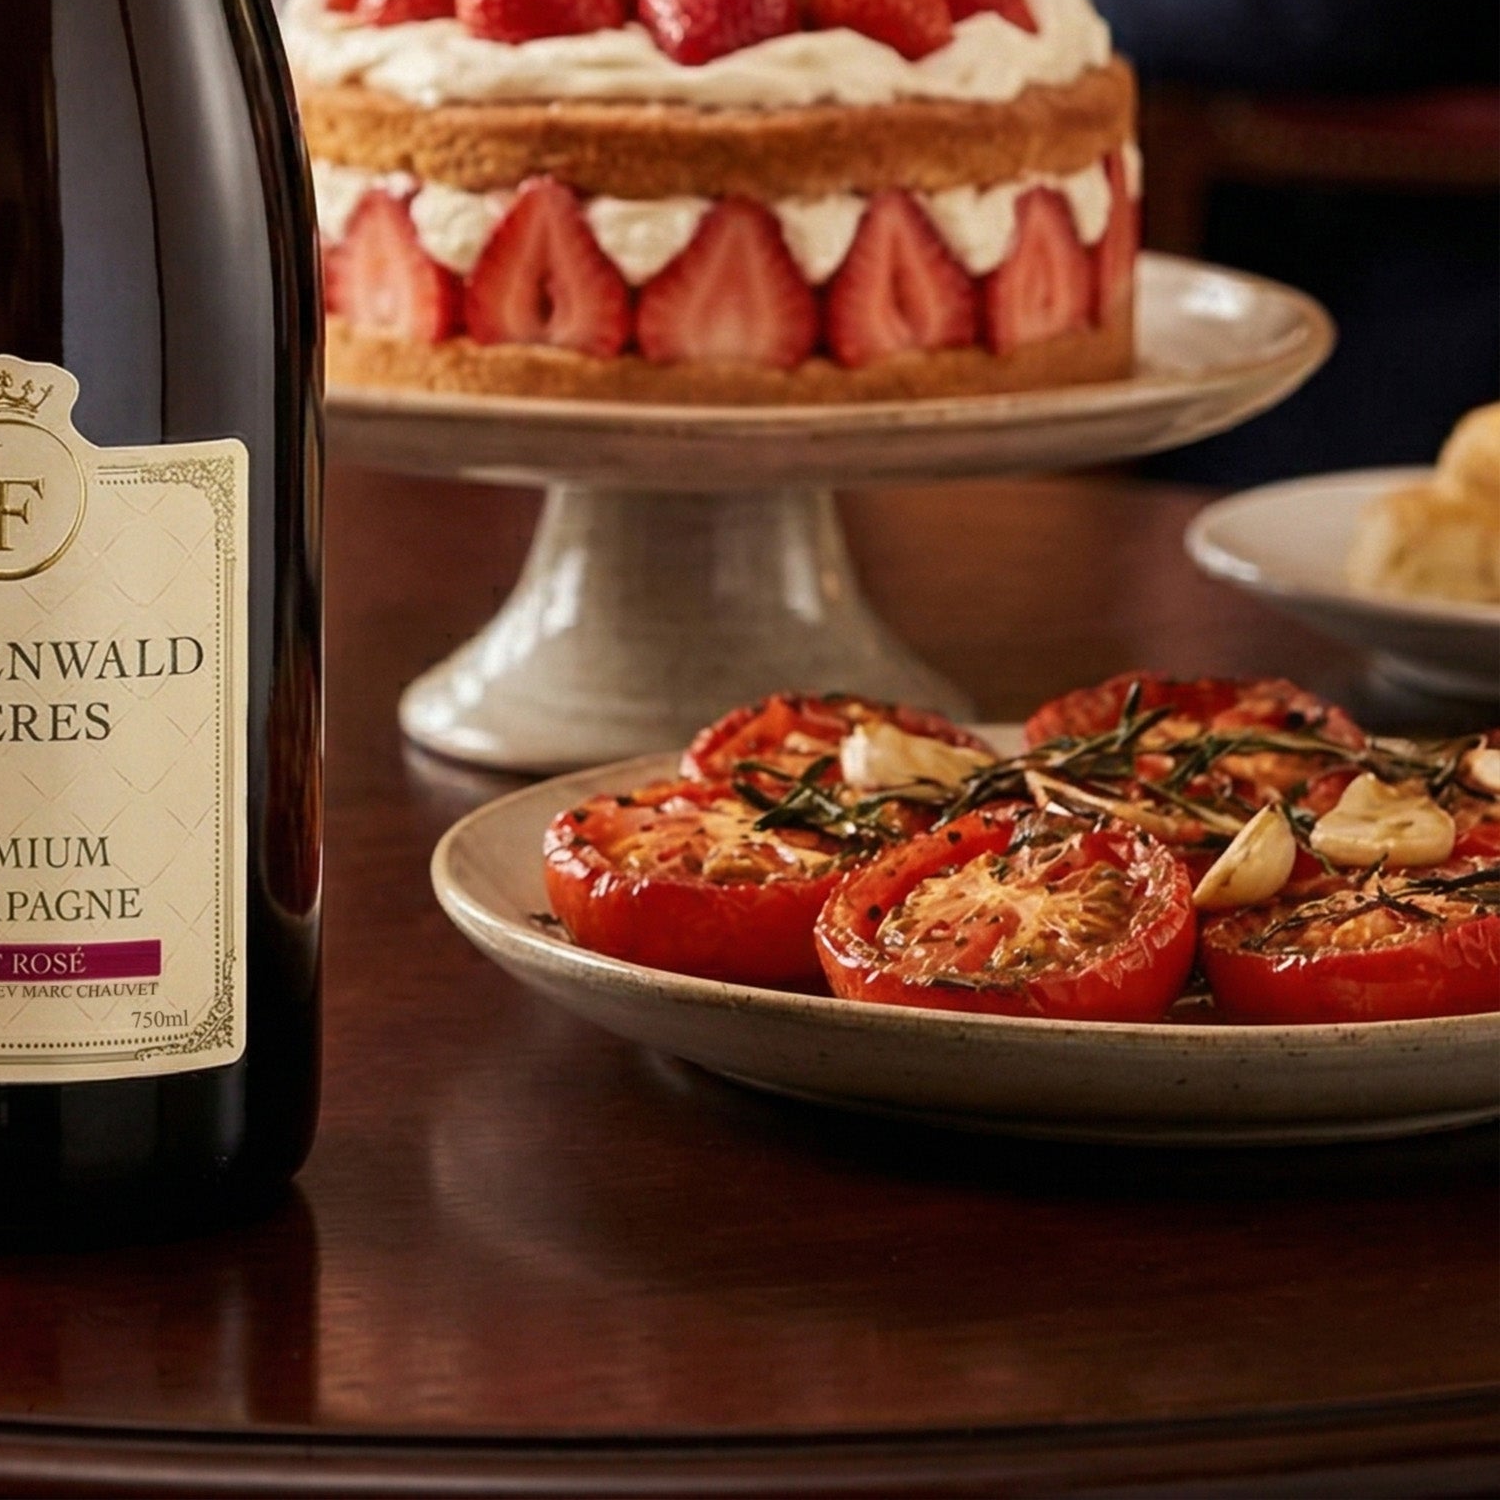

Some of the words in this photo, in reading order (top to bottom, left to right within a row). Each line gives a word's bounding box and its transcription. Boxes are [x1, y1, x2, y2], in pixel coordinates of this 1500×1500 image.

[12, 946, 87, 975] ROSÉ
[22, 985, 73, 999] MARC
[76, 982, 160, 998] CHAUVET
[131, 1009, 189, 1029] 750ml
